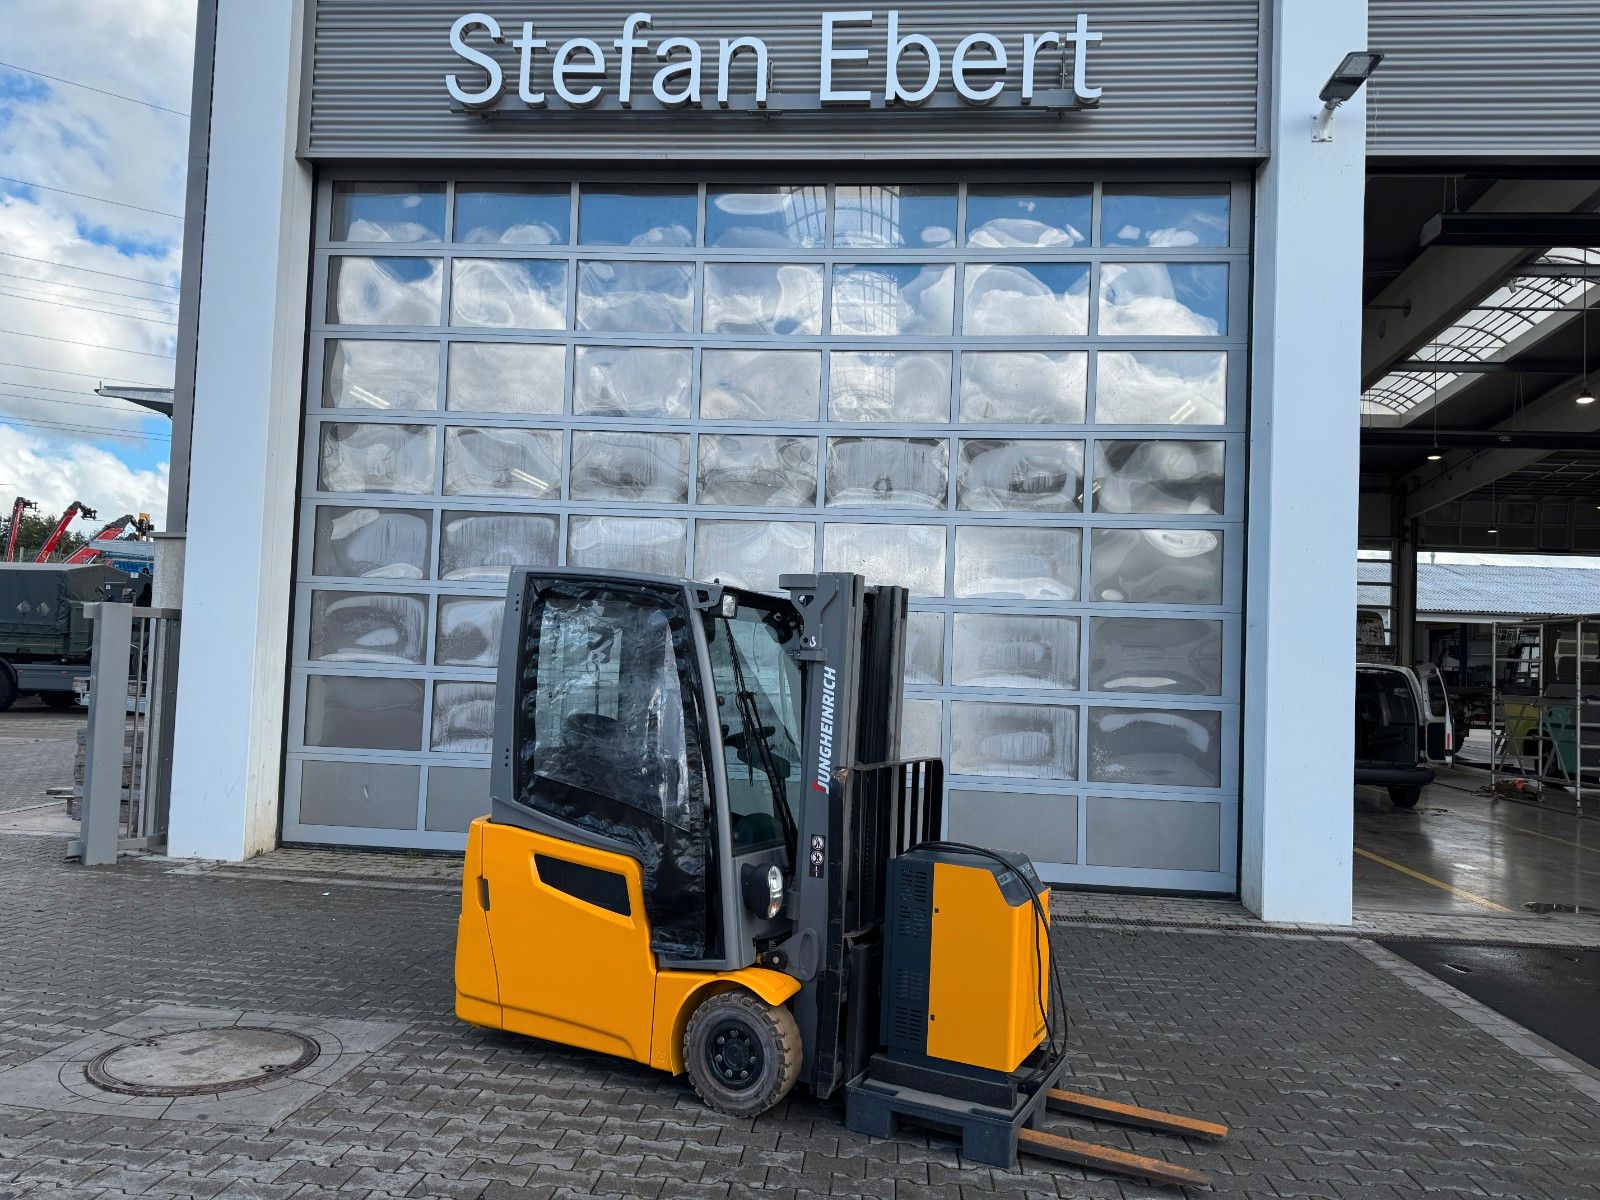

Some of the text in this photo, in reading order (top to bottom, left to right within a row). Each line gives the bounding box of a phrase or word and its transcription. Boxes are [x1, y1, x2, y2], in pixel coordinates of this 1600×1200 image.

[445, 10, 1103, 105] Stefan Ebert
[813, 666, 836, 794] JUNGHEINRICH
